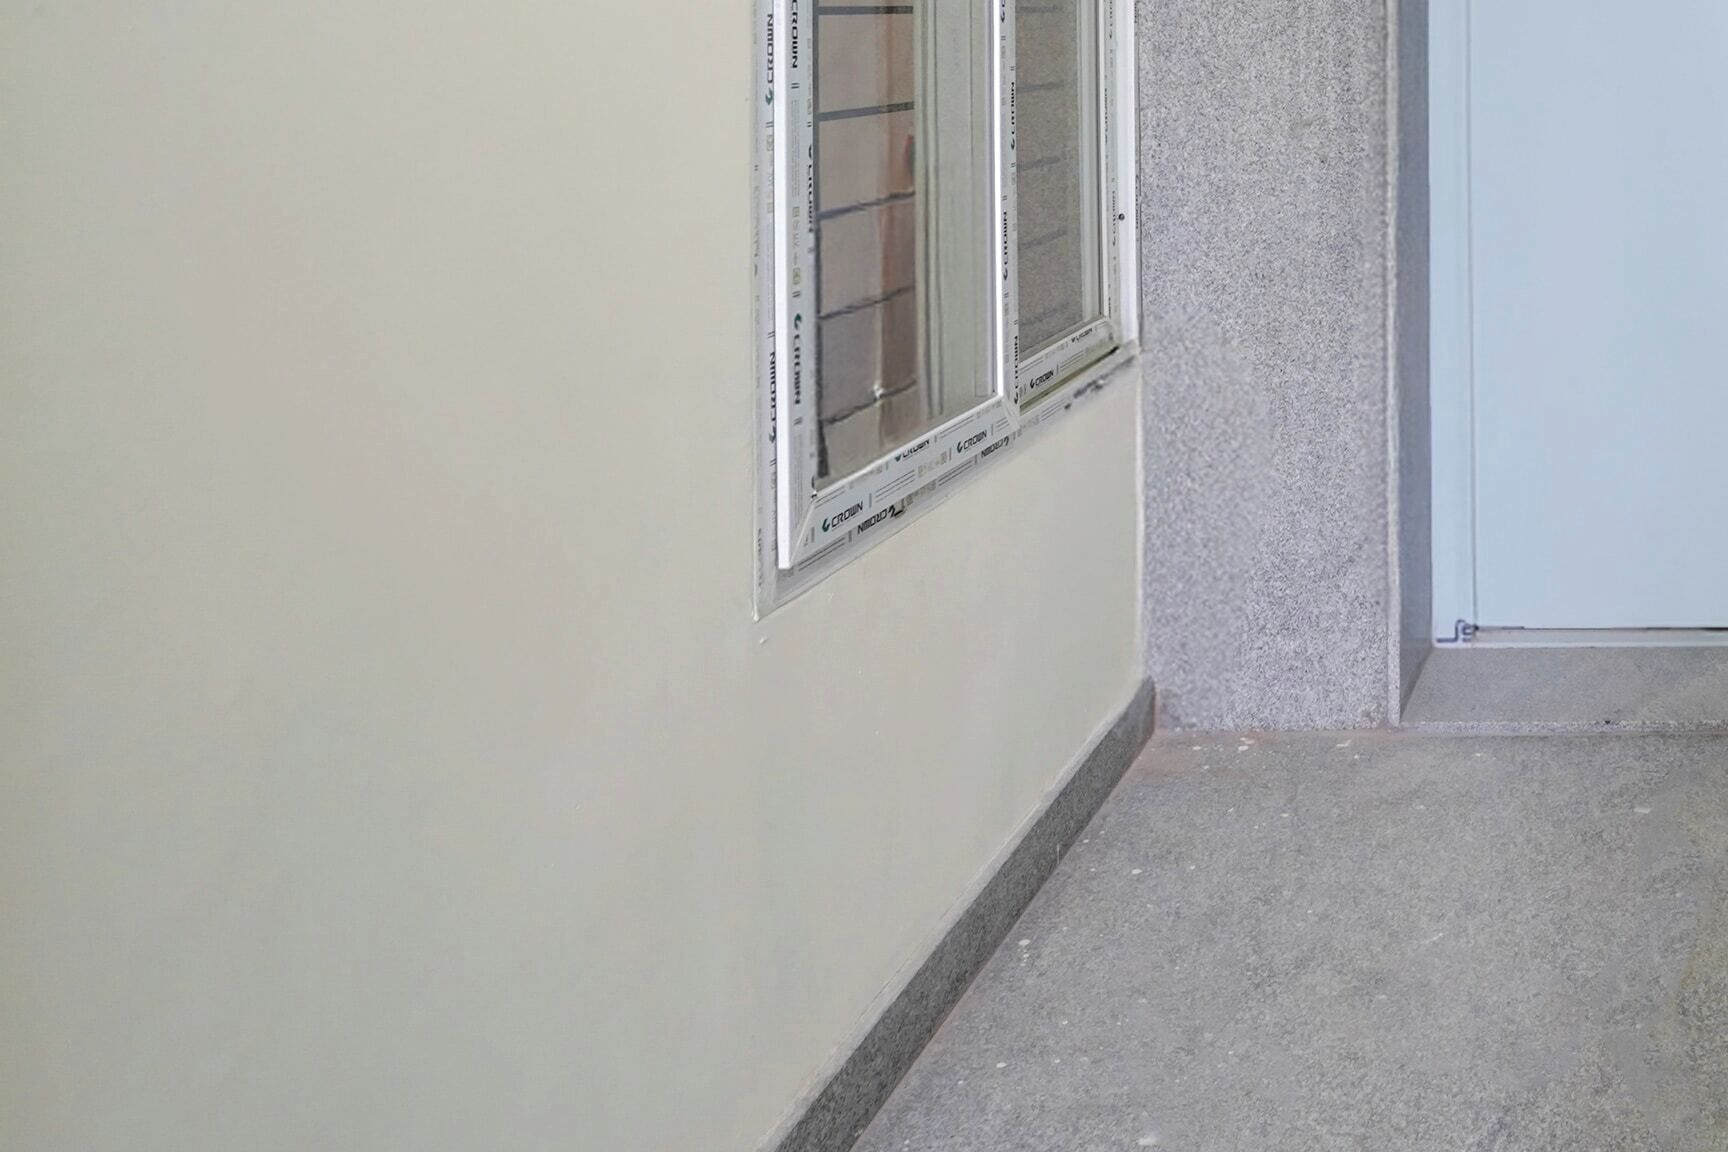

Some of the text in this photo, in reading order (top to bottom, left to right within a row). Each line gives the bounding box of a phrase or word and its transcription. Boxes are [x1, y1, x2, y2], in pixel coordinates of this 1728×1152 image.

[791, 0, 799, 68] CROWN
[766, 14, 774, 84] CROWN
[963, 429, 988, 450] CROWN
[831, 501, 864, 528] CROWN
[857, 508, 888, 534] CROWN
